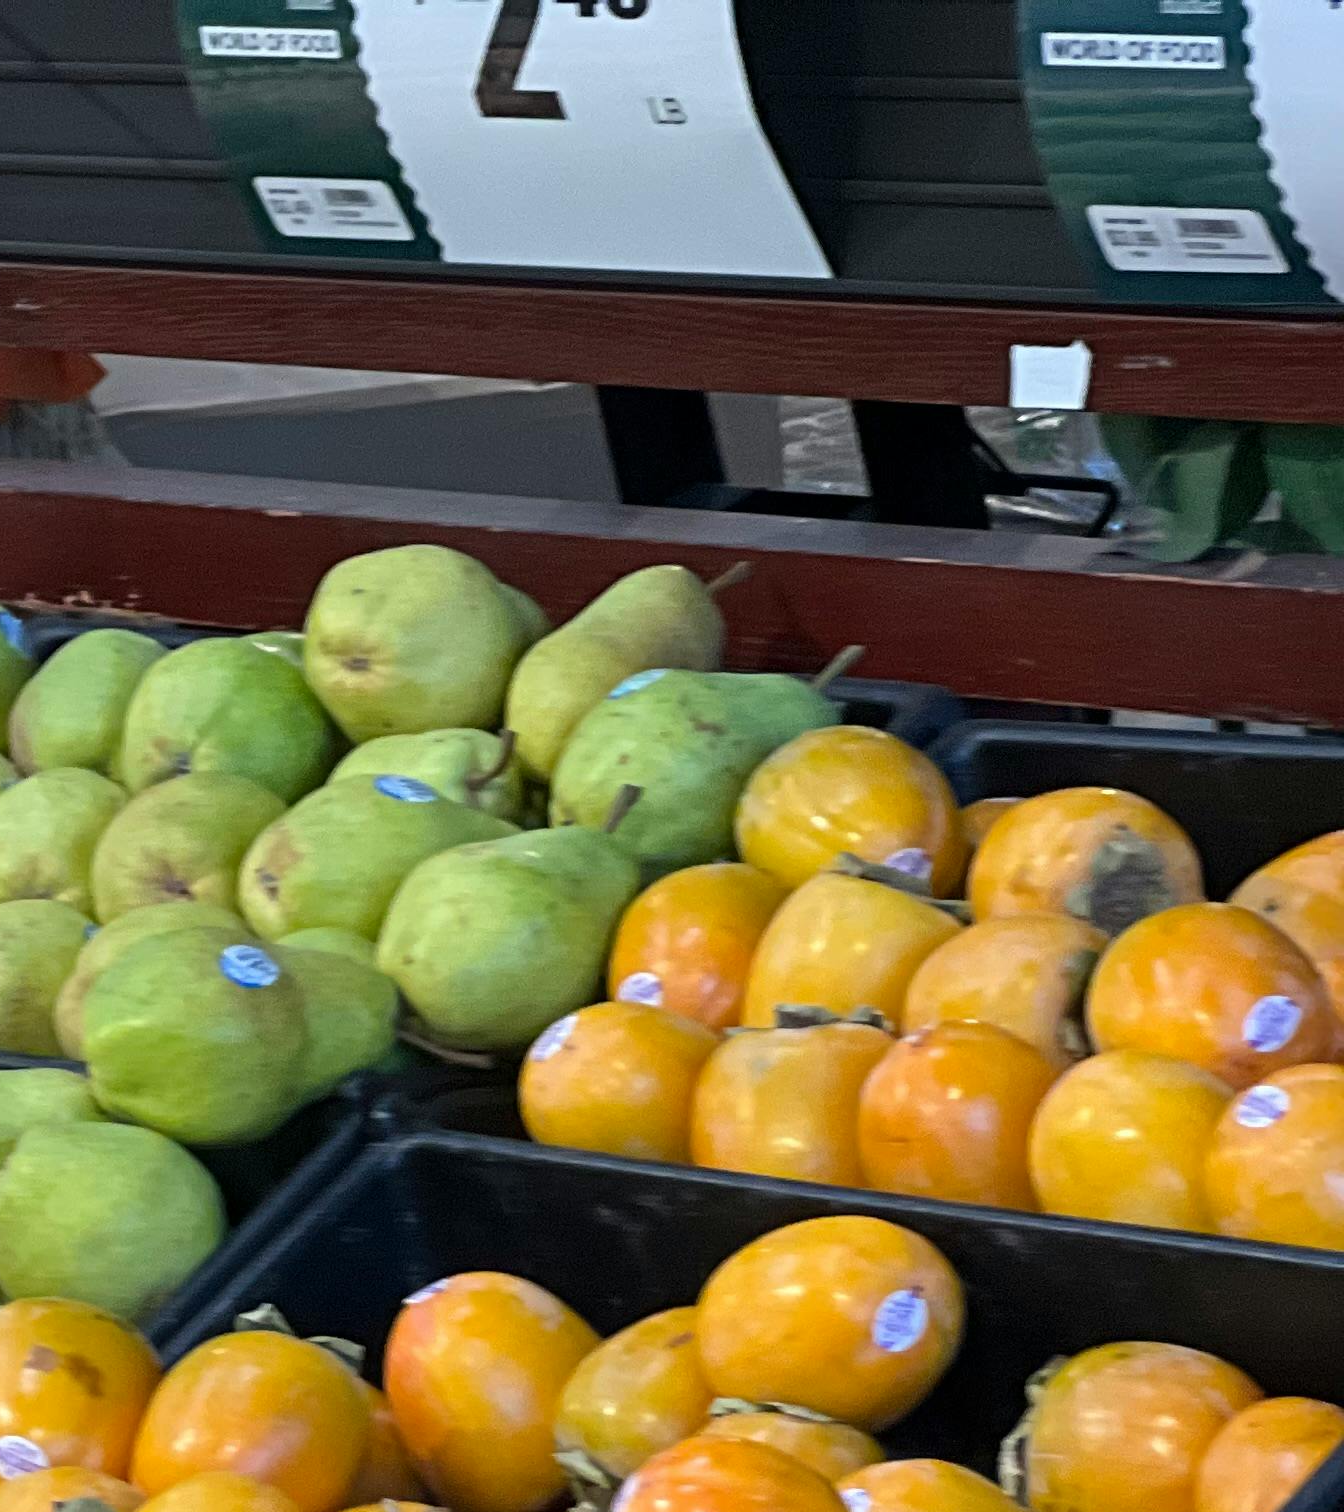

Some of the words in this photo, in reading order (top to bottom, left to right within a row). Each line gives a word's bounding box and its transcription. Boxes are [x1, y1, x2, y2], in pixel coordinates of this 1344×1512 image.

[208, 31, 261, 51] WORLD
[265, 33, 286, 52] OF
[288, 34, 335, 53] FOOD
[1052, 39, 1119, 61] WORLD
[1124, 40, 1154, 62] OF
[1159, 41, 1215, 63] FOOD
[647, 96, 688, 125] LB
